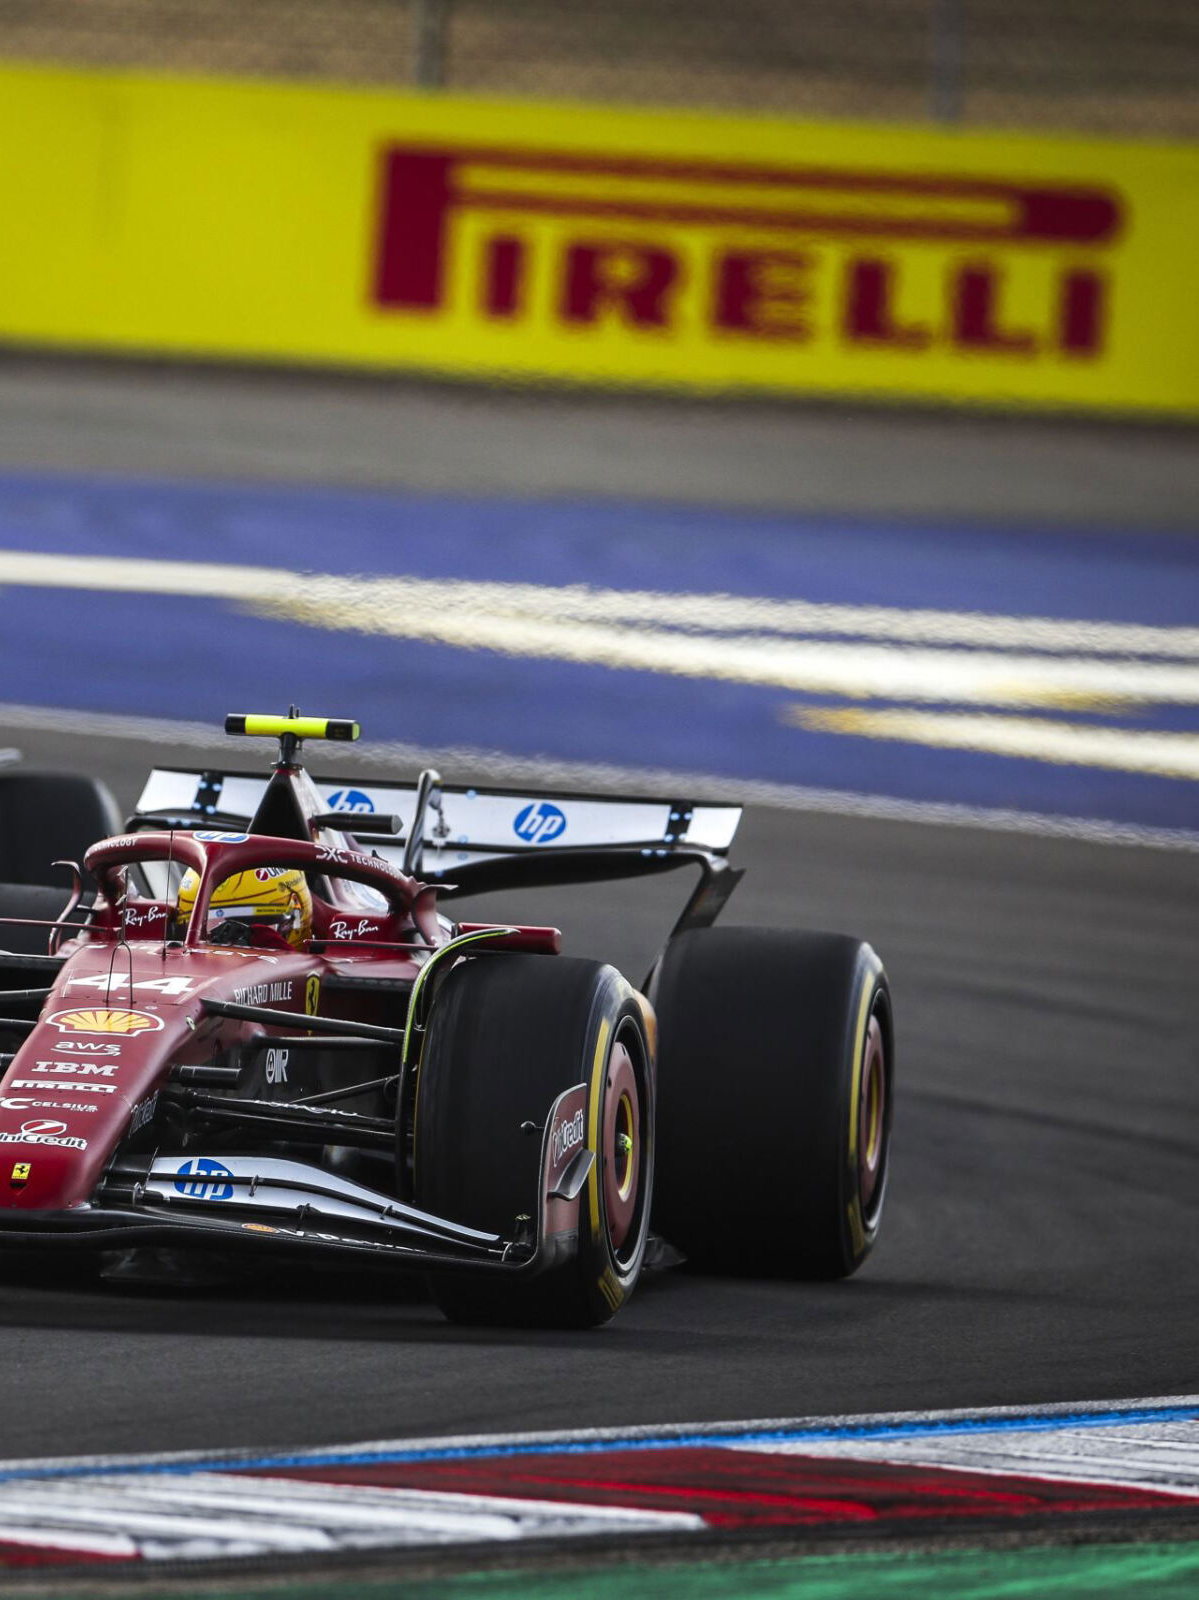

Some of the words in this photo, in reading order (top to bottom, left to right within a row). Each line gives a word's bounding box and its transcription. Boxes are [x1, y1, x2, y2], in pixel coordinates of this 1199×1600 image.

[369, 140, 1127, 360] PIRELLI
[514, 803, 566, 842] hp
[330, 919, 379, 940] Ray-Ban
[68, 972, 195, 995] 44
[270, 981, 293, 1002] MILLE
[54, 1041, 122, 1054] aws
[31, 1061, 119, 1077] IBM
[10, 1079, 118, 1094] PIRELLI
[32, 1101, 98, 1111] CELSIUS
[557, 1109, 584, 1160] Credit
[174, 1158, 234, 1200] hp
